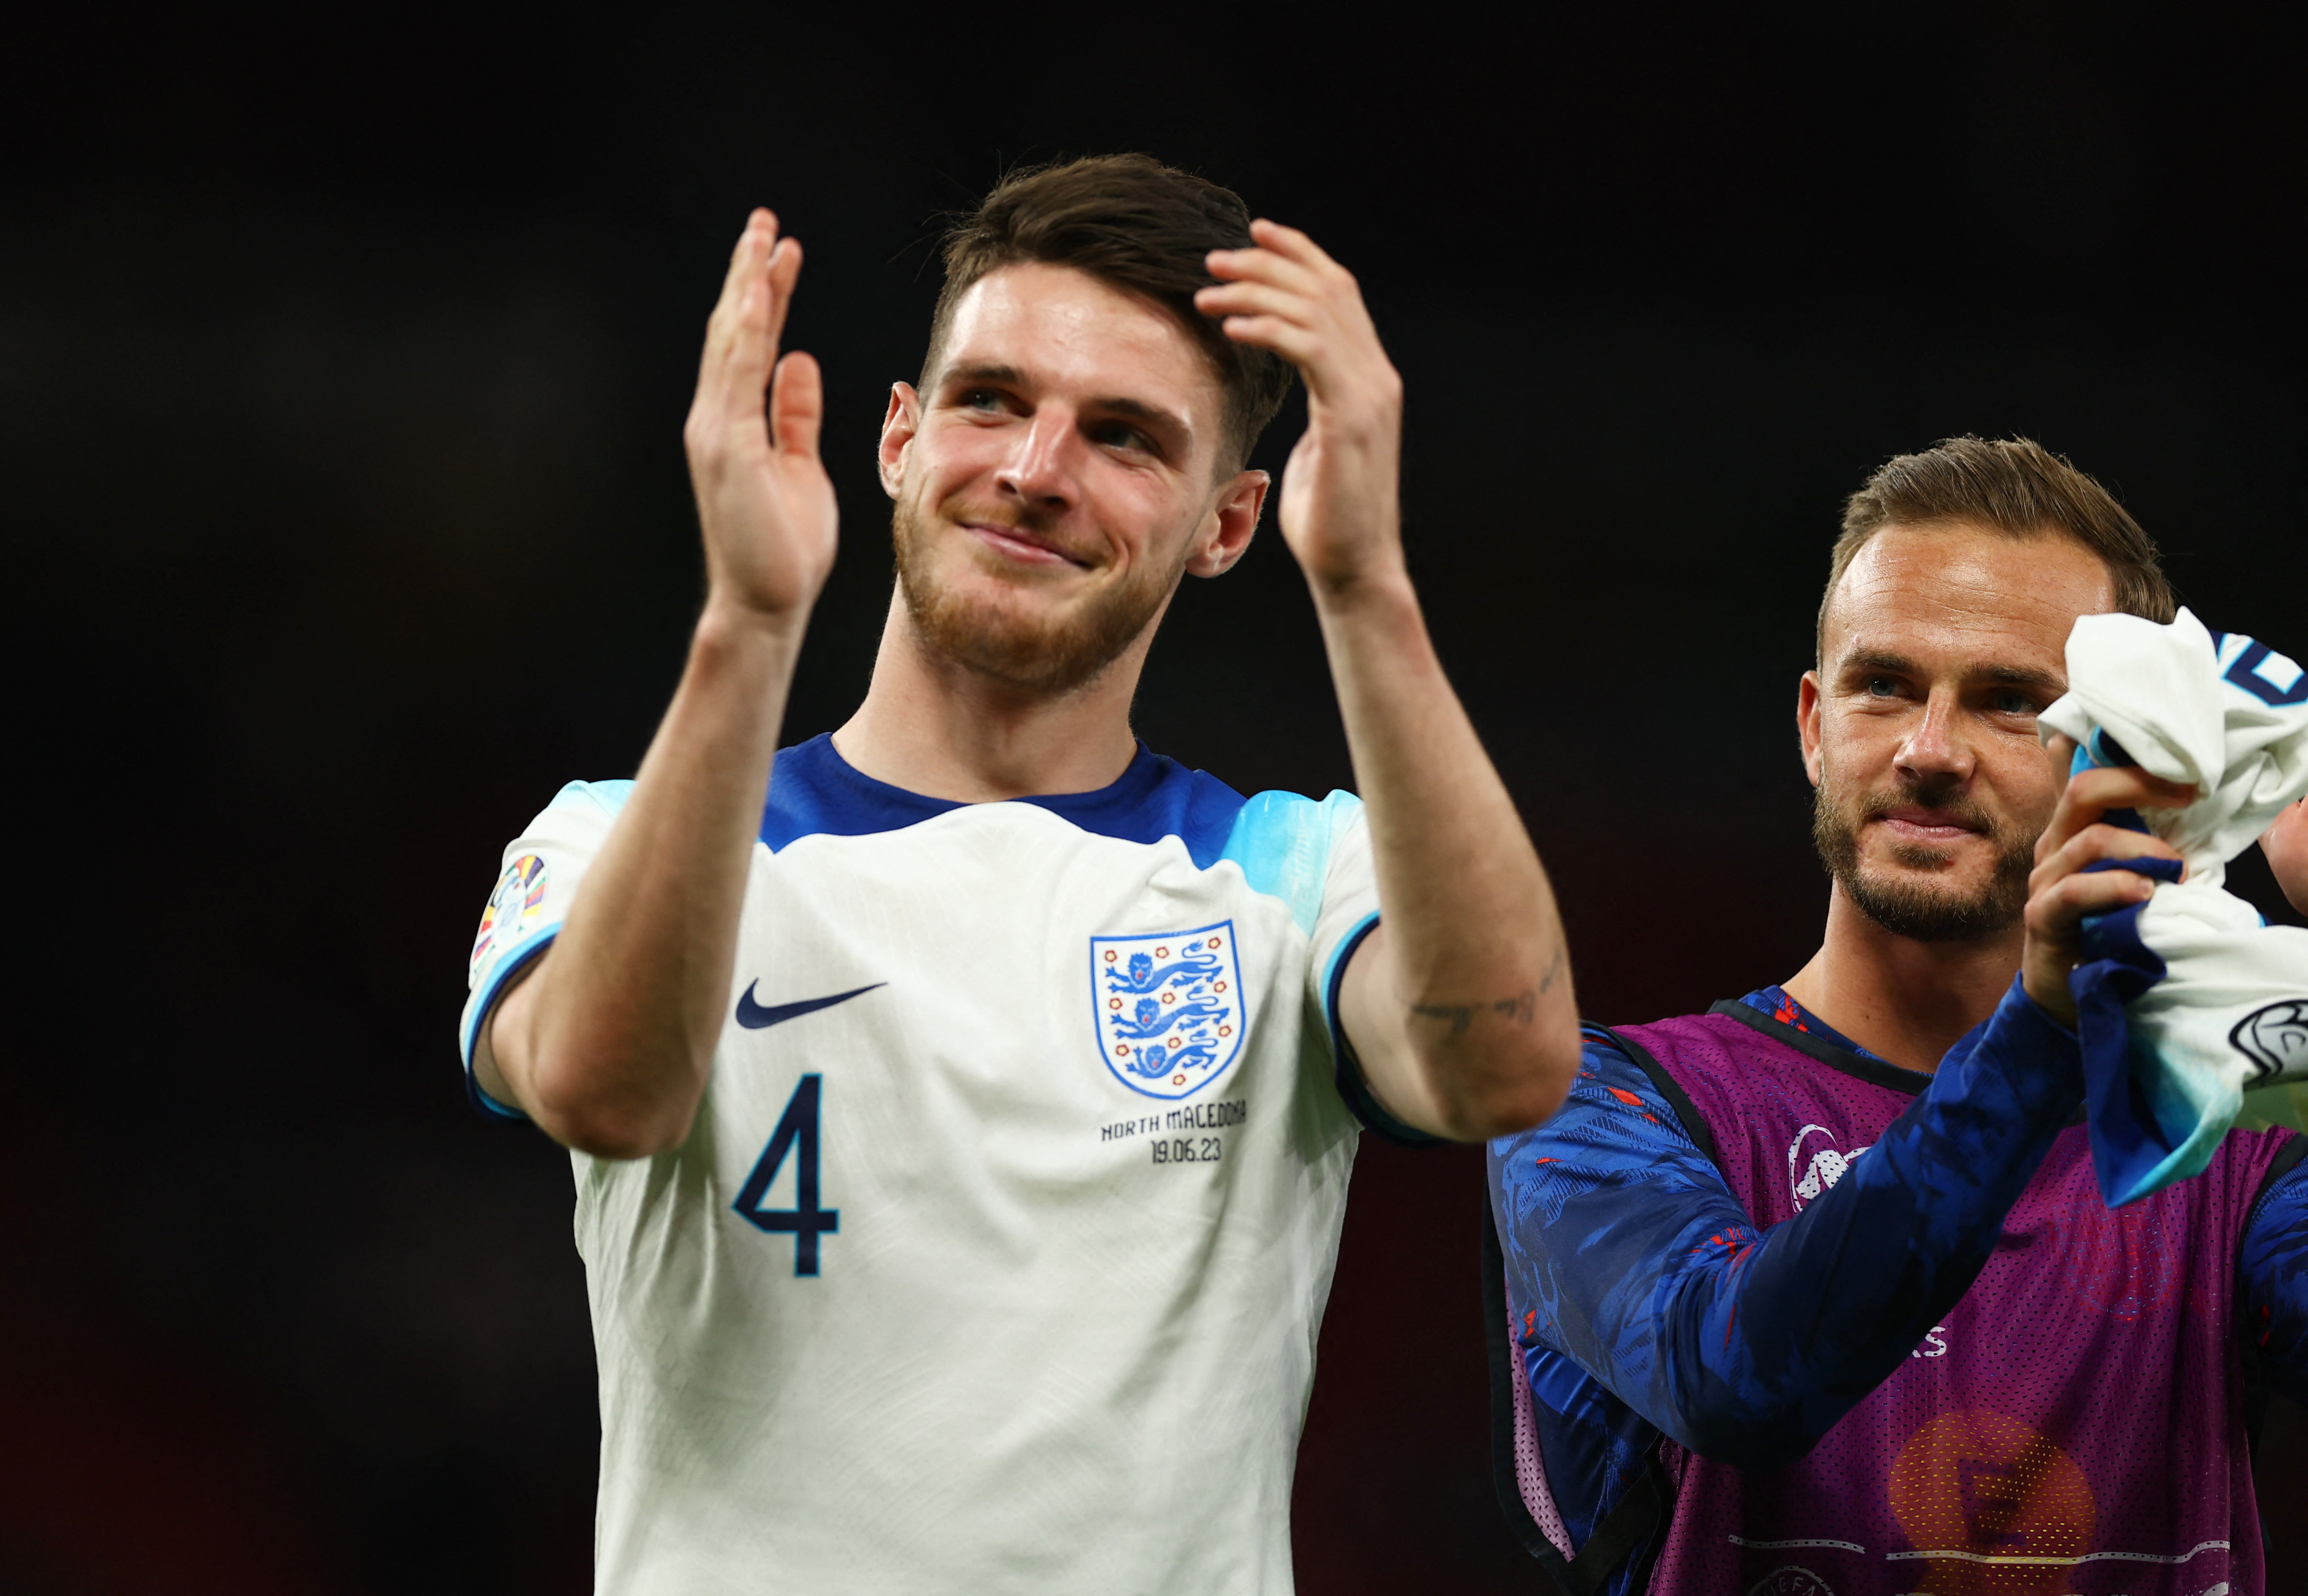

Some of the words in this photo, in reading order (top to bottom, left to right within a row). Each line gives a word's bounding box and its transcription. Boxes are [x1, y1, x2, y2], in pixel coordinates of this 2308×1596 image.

[1100, 1115, 1160, 1141] NORTH
[1166, 1099, 1247, 1129] MACEDONA
[1151, 1136, 1221, 1164] 19.06.23
[730, 1072, 840, 1277] 4
